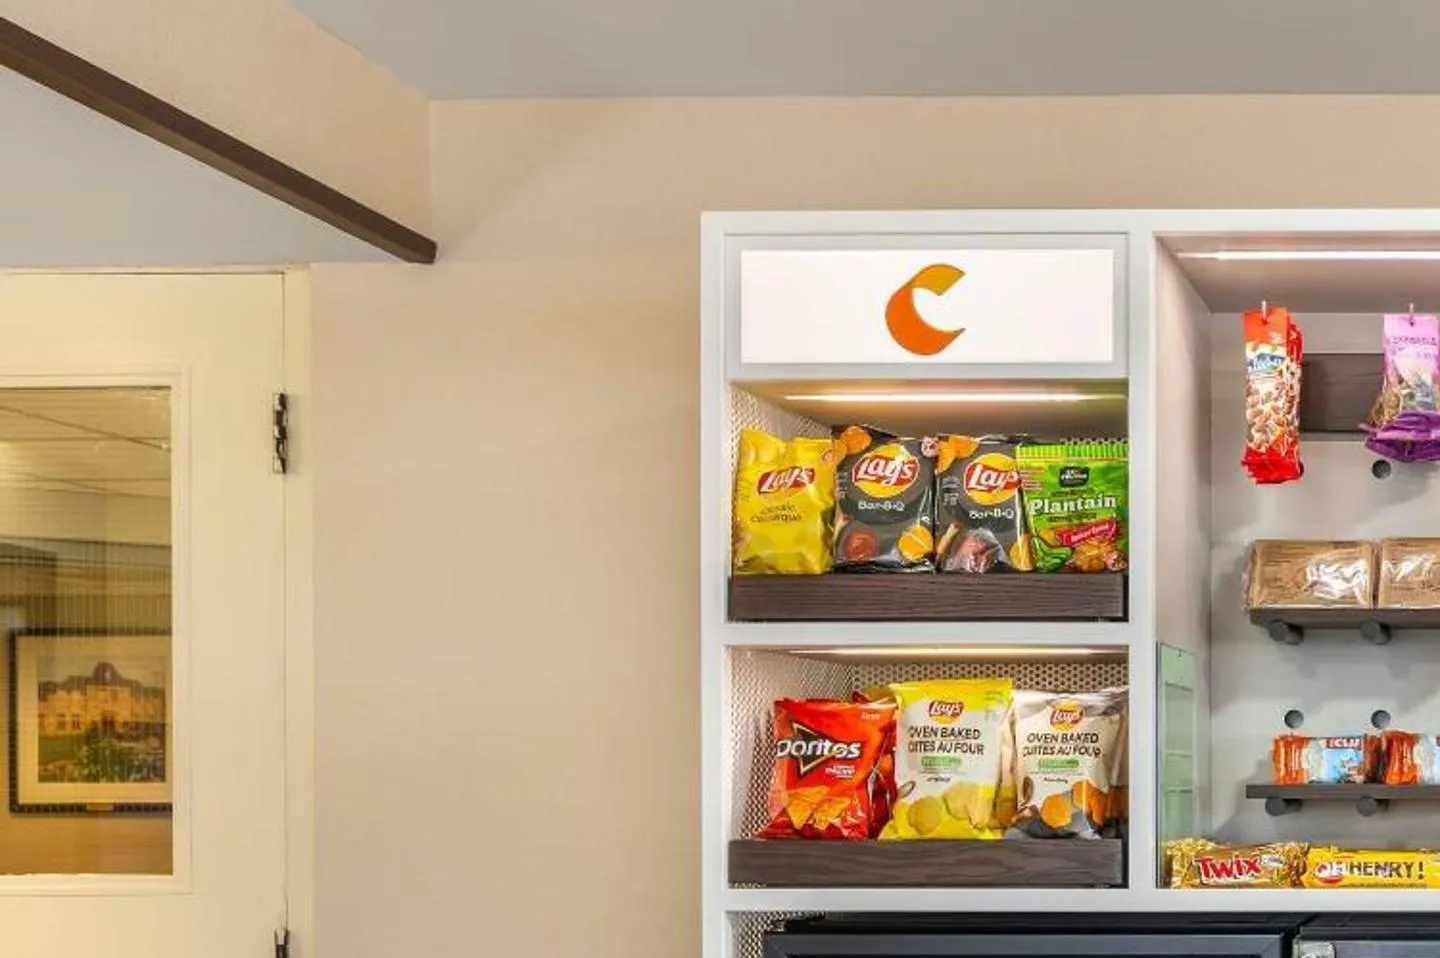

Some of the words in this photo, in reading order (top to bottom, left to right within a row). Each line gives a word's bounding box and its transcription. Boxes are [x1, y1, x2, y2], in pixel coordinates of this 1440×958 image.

[1029, 493, 1117, 515] Plantain
[940, 728, 981, 739] BAKED
[1027, 733, 1058, 743] OVEN
[776, 739, 861, 758] Doritos
[954, 743, 984, 755] FOUR
